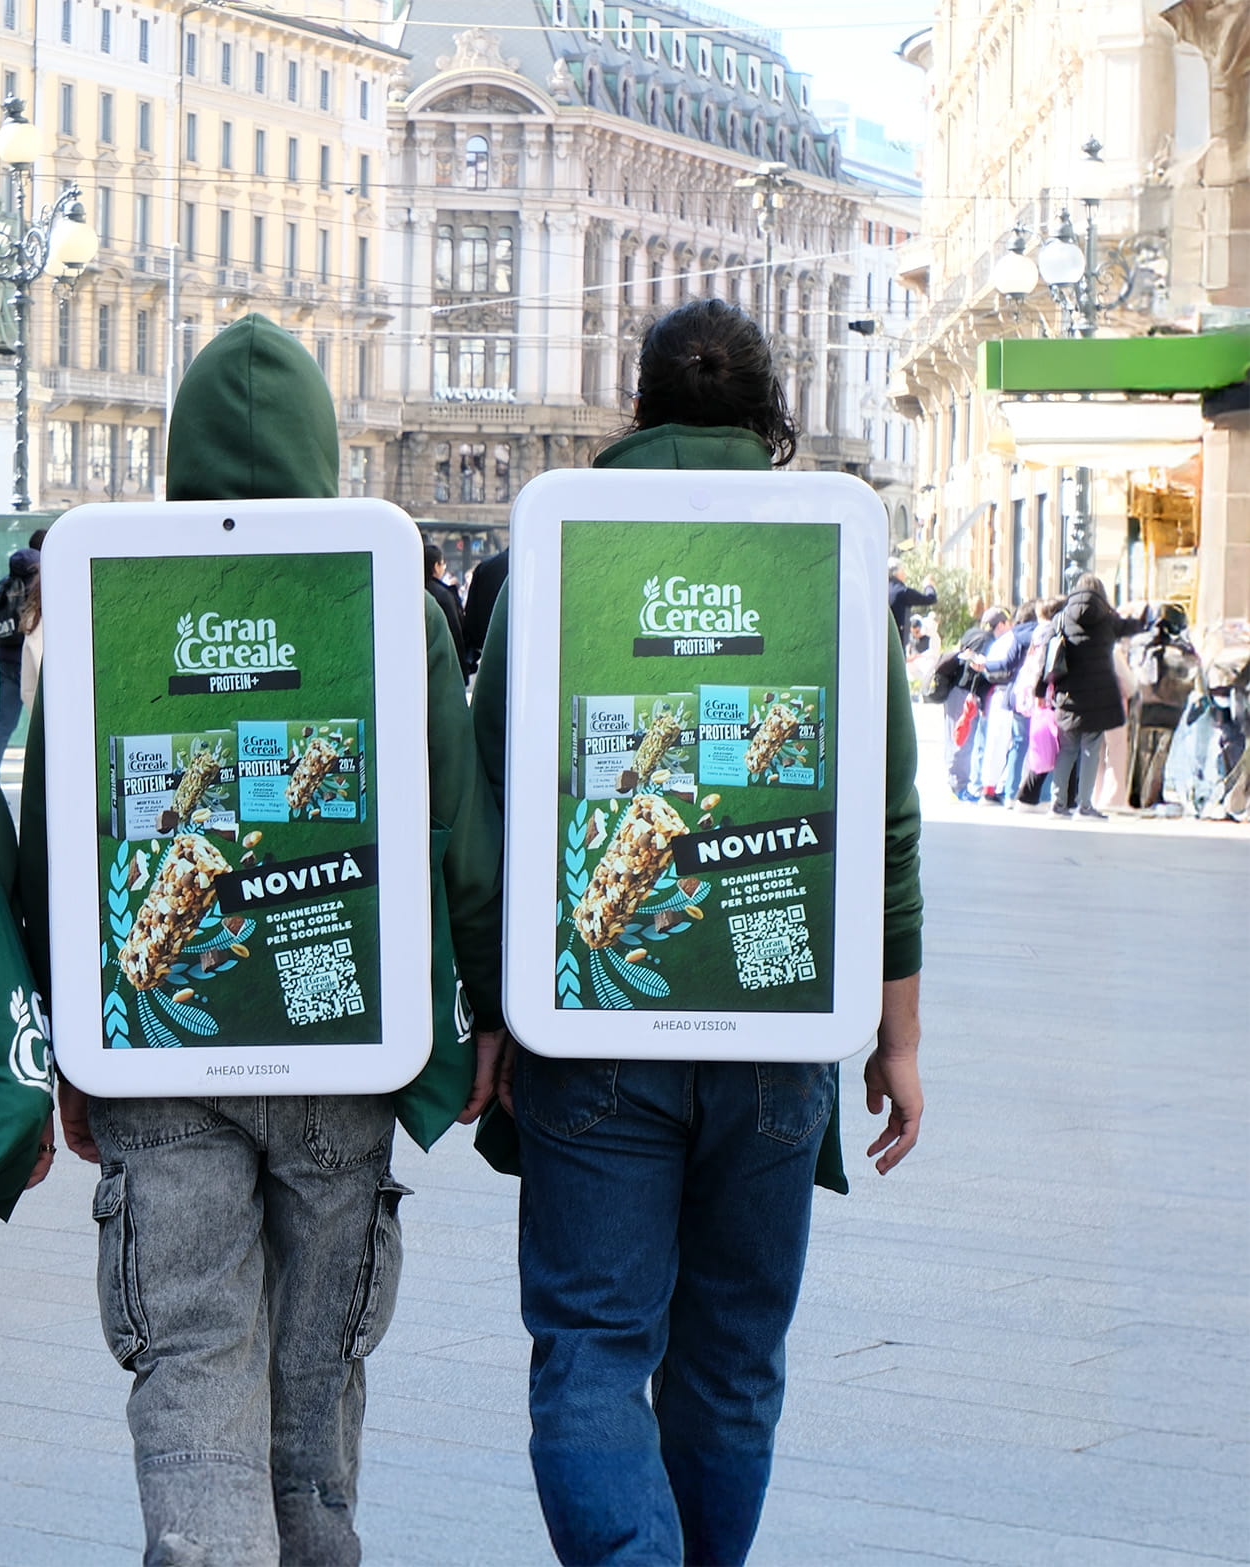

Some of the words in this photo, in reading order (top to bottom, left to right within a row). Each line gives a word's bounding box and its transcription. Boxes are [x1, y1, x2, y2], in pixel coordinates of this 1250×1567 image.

[435, 382, 516, 401] wework
[664, 576, 742, 606] Gran
[646, 601, 760, 632] Cereale
[198, 612, 276, 642] Gran
[180, 638, 296, 669] Cereale
[673, 638, 723, 655] PROTEIN+
[209, 674, 260, 693] PROTEIN+
[706, 708, 745, 719] Cereale
[712, 700, 738, 710] Gran
[592, 720, 630, 731] Cereale
[598, 711, 624, 722] Gran
[251, 736, 277, 746] Gran
[699, 725, 750, 740] PROTEIN+
[244, 744, 283, 755] Cereale
[585, 735, 635, 755] PROTEIN+
[130, 760, 168, 771] Cereale
[136, 751, 162, 761] Gran
[238, 760, 290, 776] PROTEIN+
[124, 775, 174, 795] PROTEIN+
[698, 818, 818, 864] NOVITÀ
[240, 852, 362, 901] NOVITÀ
[721, 866, 799, 887] SCANNERIZZA
[731, 886, 742, 897] IL
[744, 883, 760, 895] QR
[762, 878, 793, 890] CODE
[720, 898, 744, 909] PER
[745, 887, 807, 904] SCOPRIRLE
[266, 900, 344, 923] SCANNERIZZA
[276, 922, 287, 932] IL
[289, 918, 305, 931] QR
[308, 912, 338, 926] CODE
[266, 933, 288, 946] PER
[291, 921, 352, 939] SCOPRIRLE
[653, 1020, 692, 1031] AHEAD
[693, 1020, 737, 1031] VISION
[206, 1066, 244, 1076] AHEAD
[247, 1064, 290, 1075] VISION
